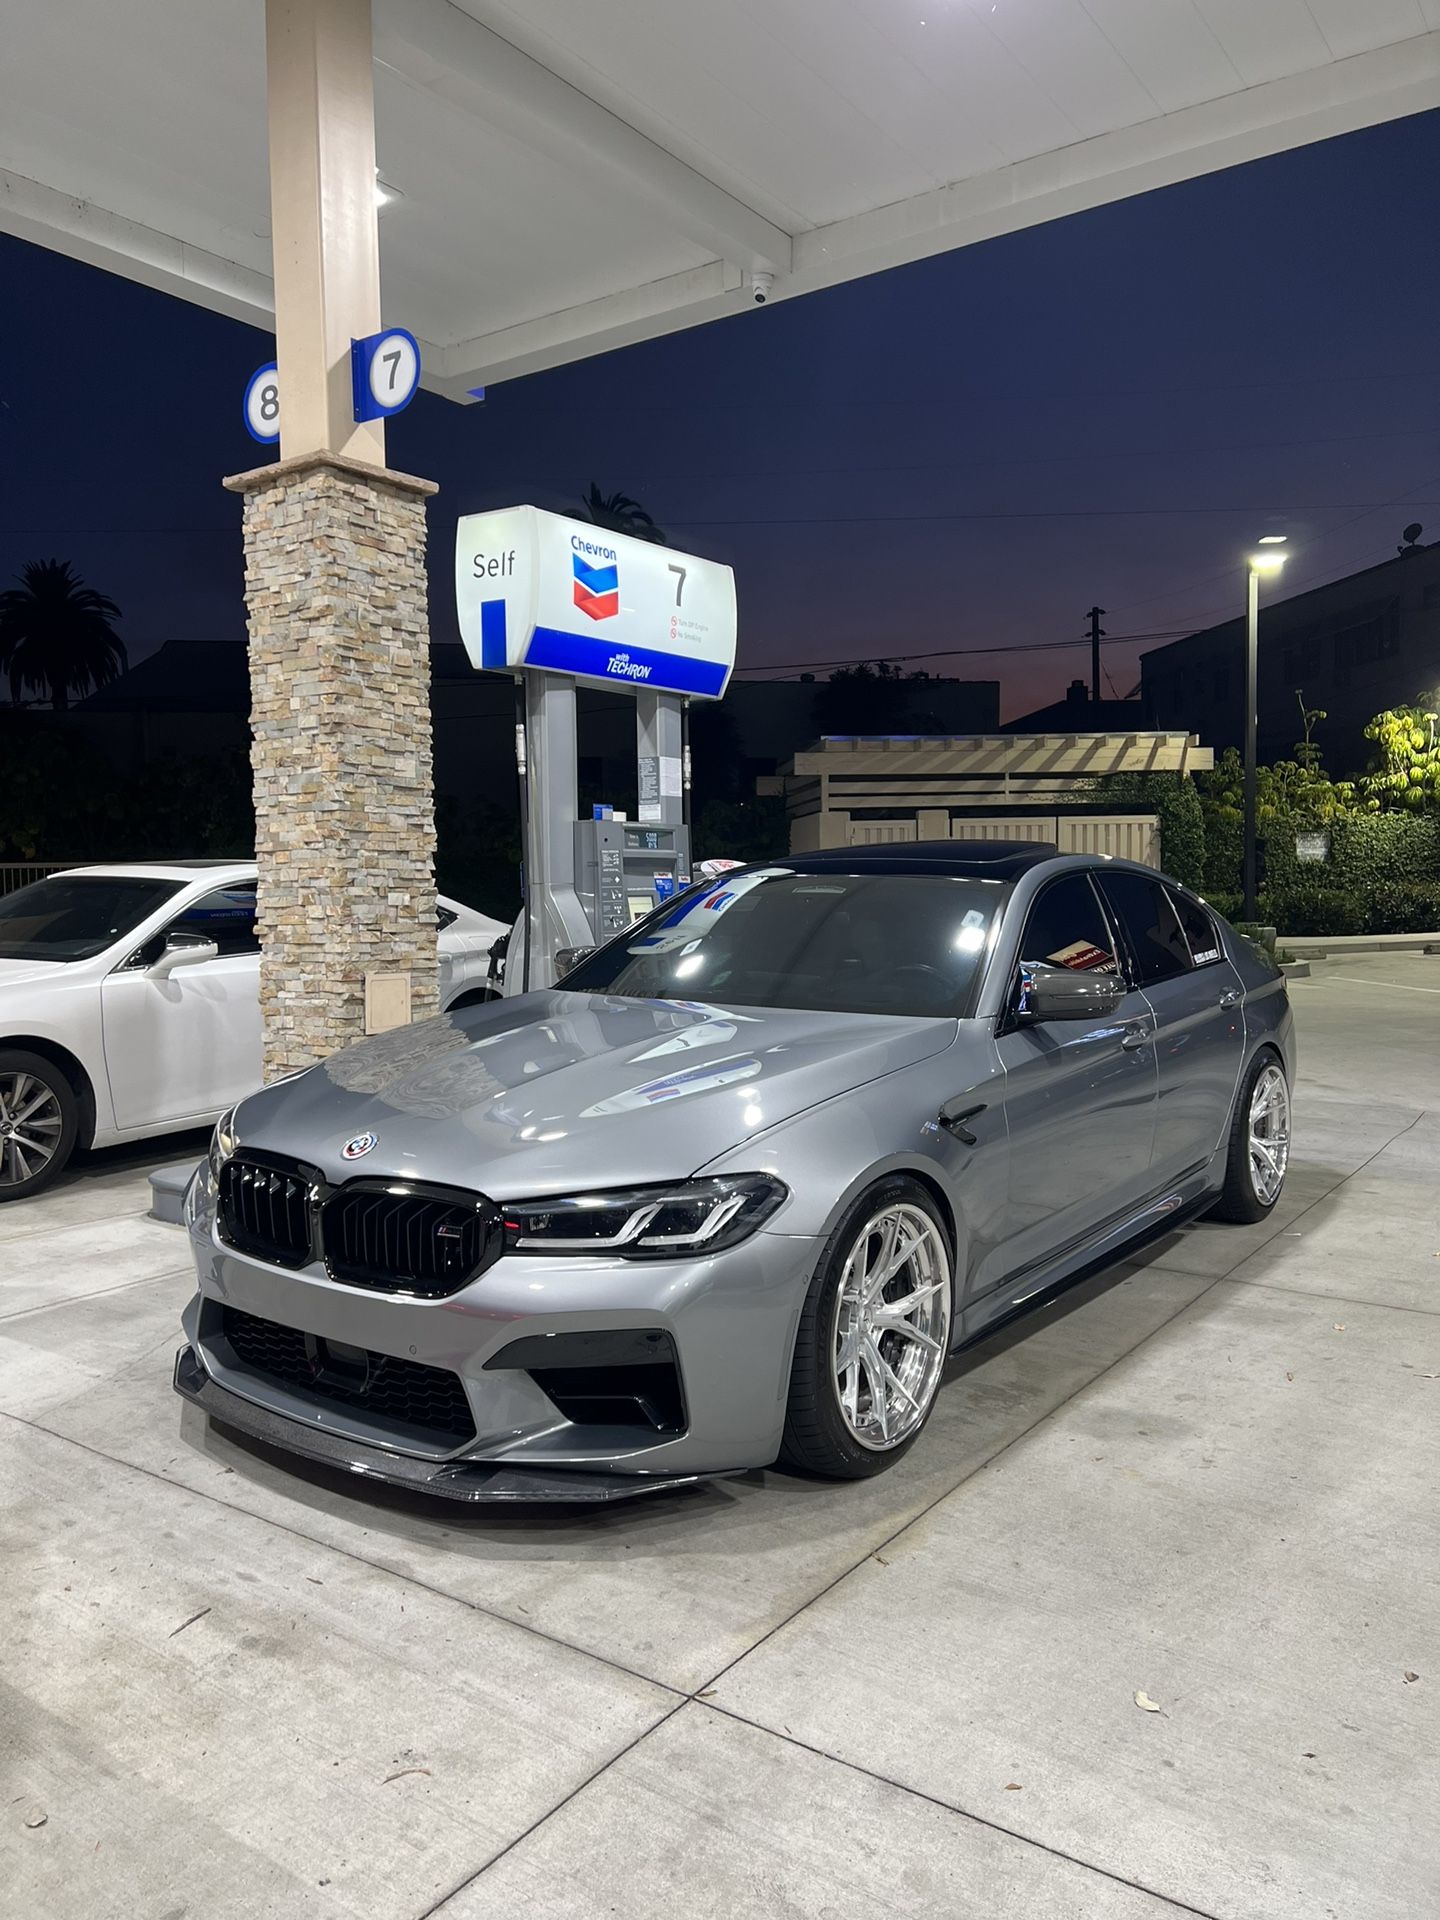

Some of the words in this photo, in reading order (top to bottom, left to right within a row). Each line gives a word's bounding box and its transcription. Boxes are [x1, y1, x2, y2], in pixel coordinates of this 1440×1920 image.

[383, 350, 401, 390] 7
[261, 385, 279, 420] 8
[571, 535, 617, 561] Chevron
[473, 550, 515, 578] Self
[668, 563, 686, 607] 7
[607, 657, 652, 679] TECHRON
[615, 653, 630, 662] with
